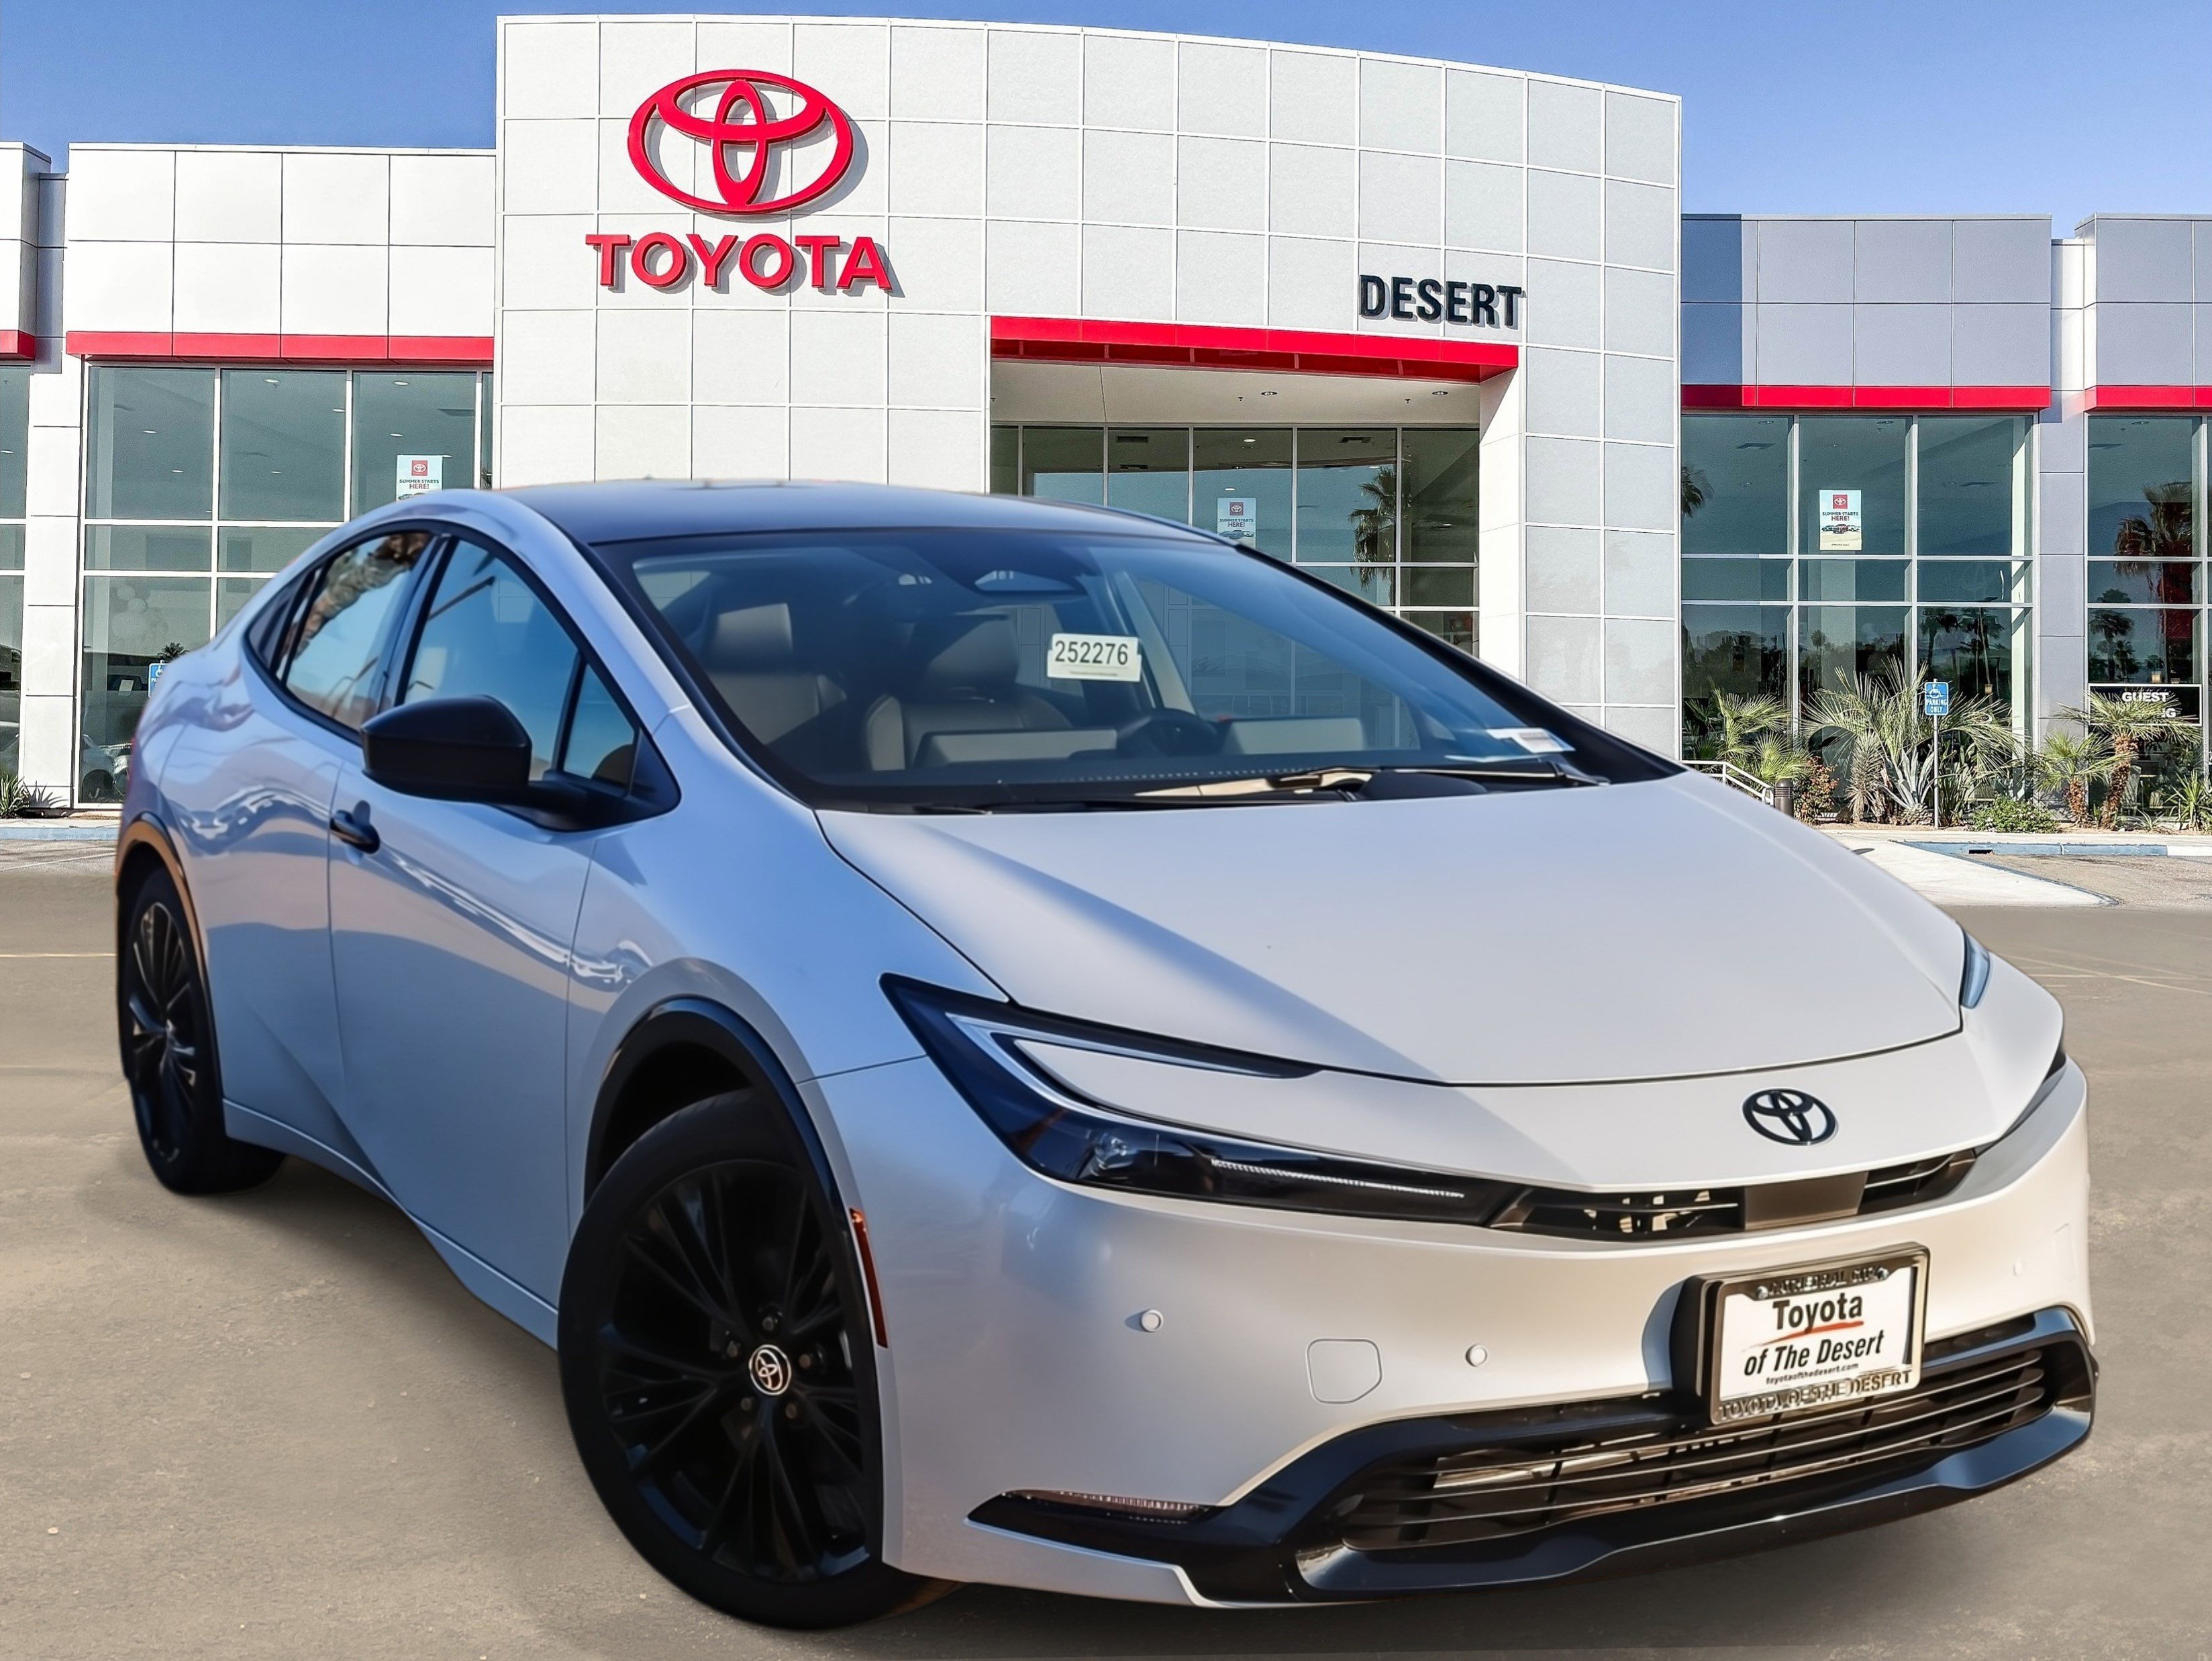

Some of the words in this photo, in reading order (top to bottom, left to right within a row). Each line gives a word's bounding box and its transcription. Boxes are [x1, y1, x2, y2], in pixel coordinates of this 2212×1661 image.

[585, 232, 893, 291] TOYOTA
[1359, 274, 1522, 327] DESERT
[1054, 640, 1129, 666] 252276
[2121, 691, 2169, 703] GUEST
[1772, 1293, 1863, 1334] Toyota
[1744, 1348, 1768, 1376] of
[1773, 1344, 1810, 1372] The
[1816, 1329, 1884, 1364] Desert
[1766, 1363, 1859, 1385] toyotaofthedesert.com
[1848, 1368, 1912, 1396] DESERT
